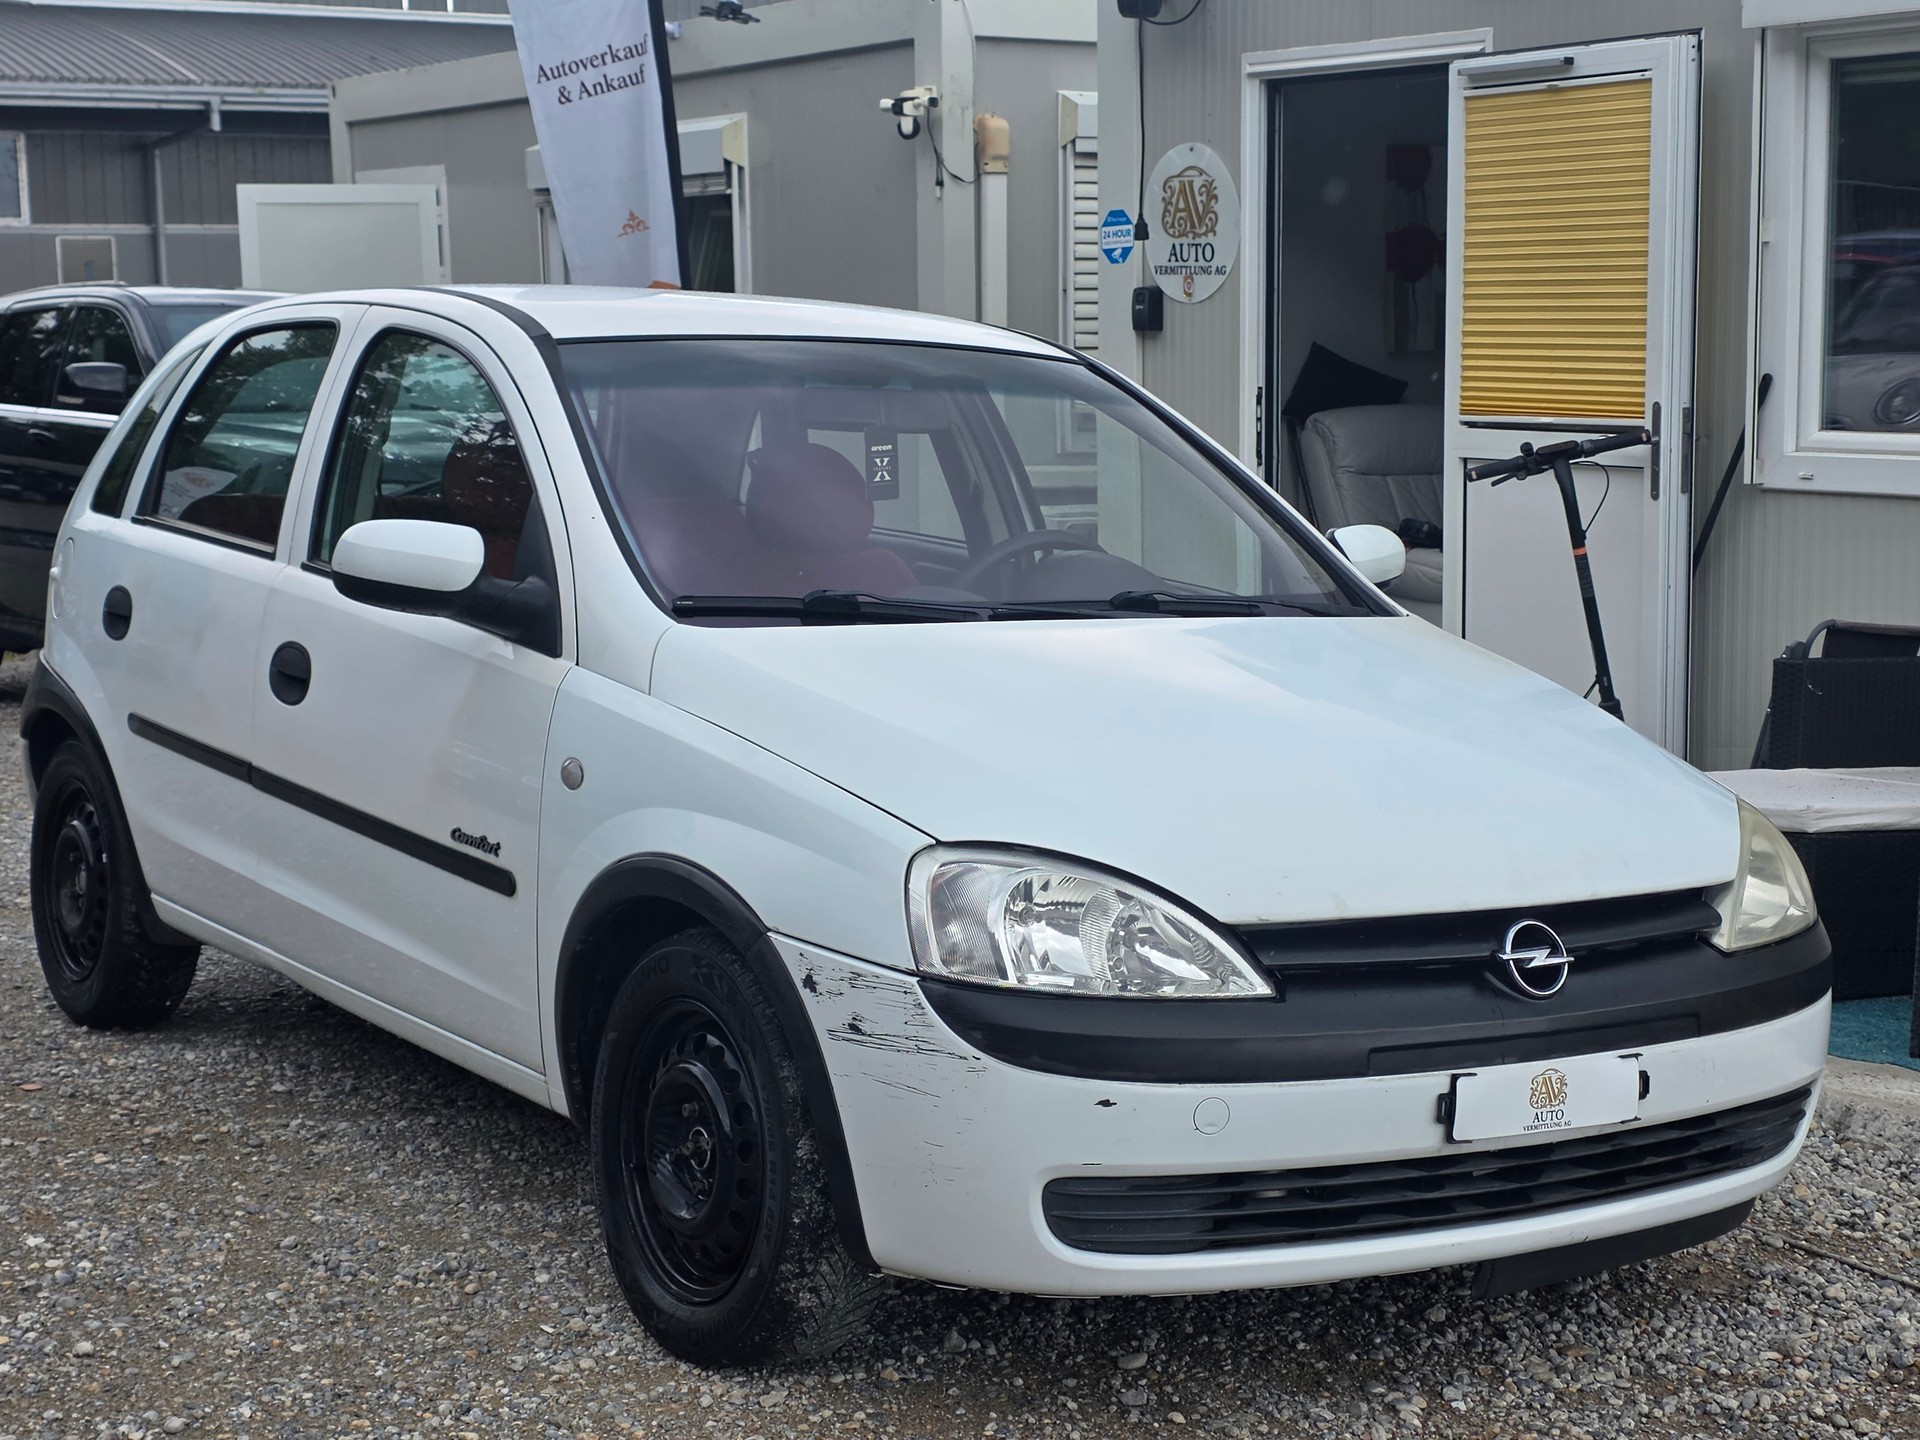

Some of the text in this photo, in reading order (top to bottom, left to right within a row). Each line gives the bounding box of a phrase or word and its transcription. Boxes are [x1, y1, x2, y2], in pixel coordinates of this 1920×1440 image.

[537, 33, 648, 84] Autoverkauf
[558, 63, 645, 105] & Ankauf
[1103, 229, 1132, 239] 24 HOUR
[1167, 243, 1215, 263] AUTO
[1154, 265, 1227, 276] VERMITTLUNG AG
[450, 827, 501, 858] Comfort
[1533, 1109, 1564, 1123] AUTO
[1523, 1120, 1572, 1132] VERMITTLUNG AG
